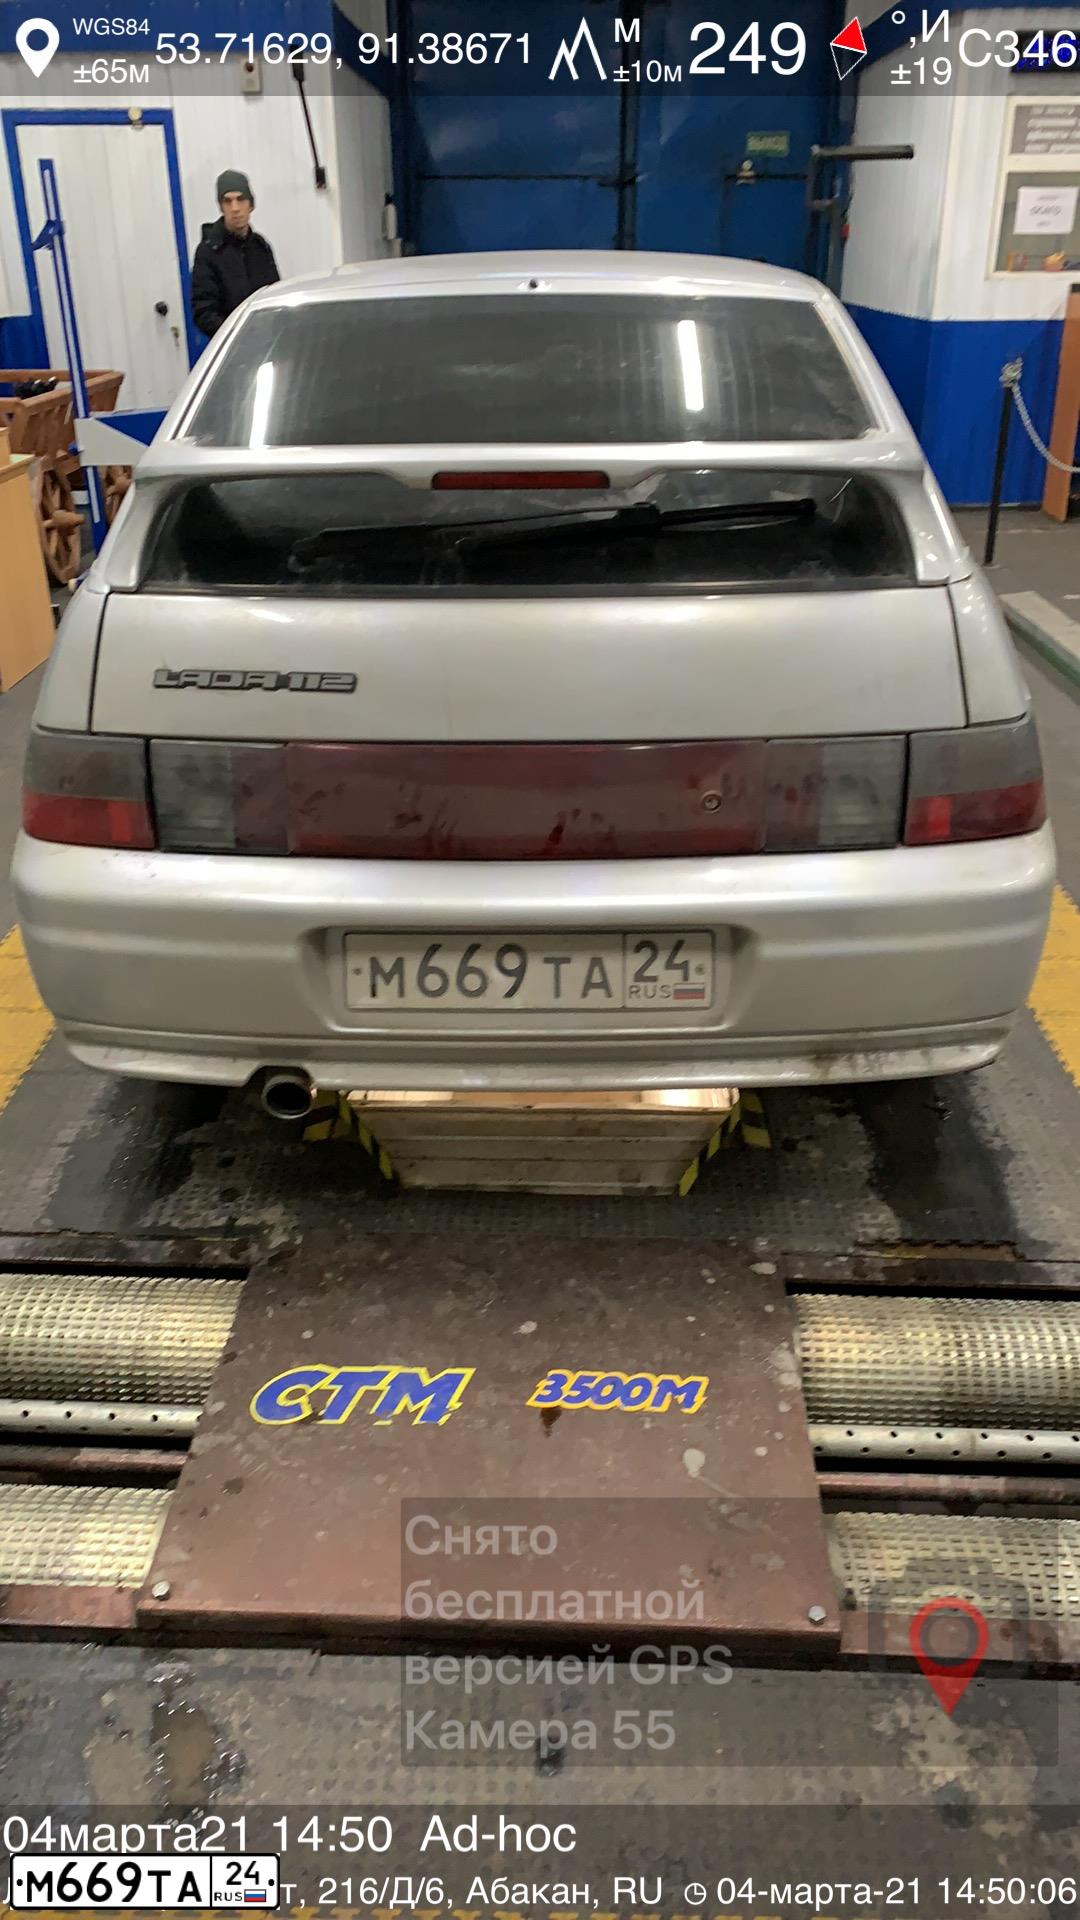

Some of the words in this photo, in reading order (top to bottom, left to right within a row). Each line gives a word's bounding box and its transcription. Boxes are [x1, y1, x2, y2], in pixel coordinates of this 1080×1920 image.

[153, 668, 281, 691] LADA
[286, 671, 358, 694] 112
[632, 939, 690, 983] 24
[628, 984, 672, 1000] RUS
